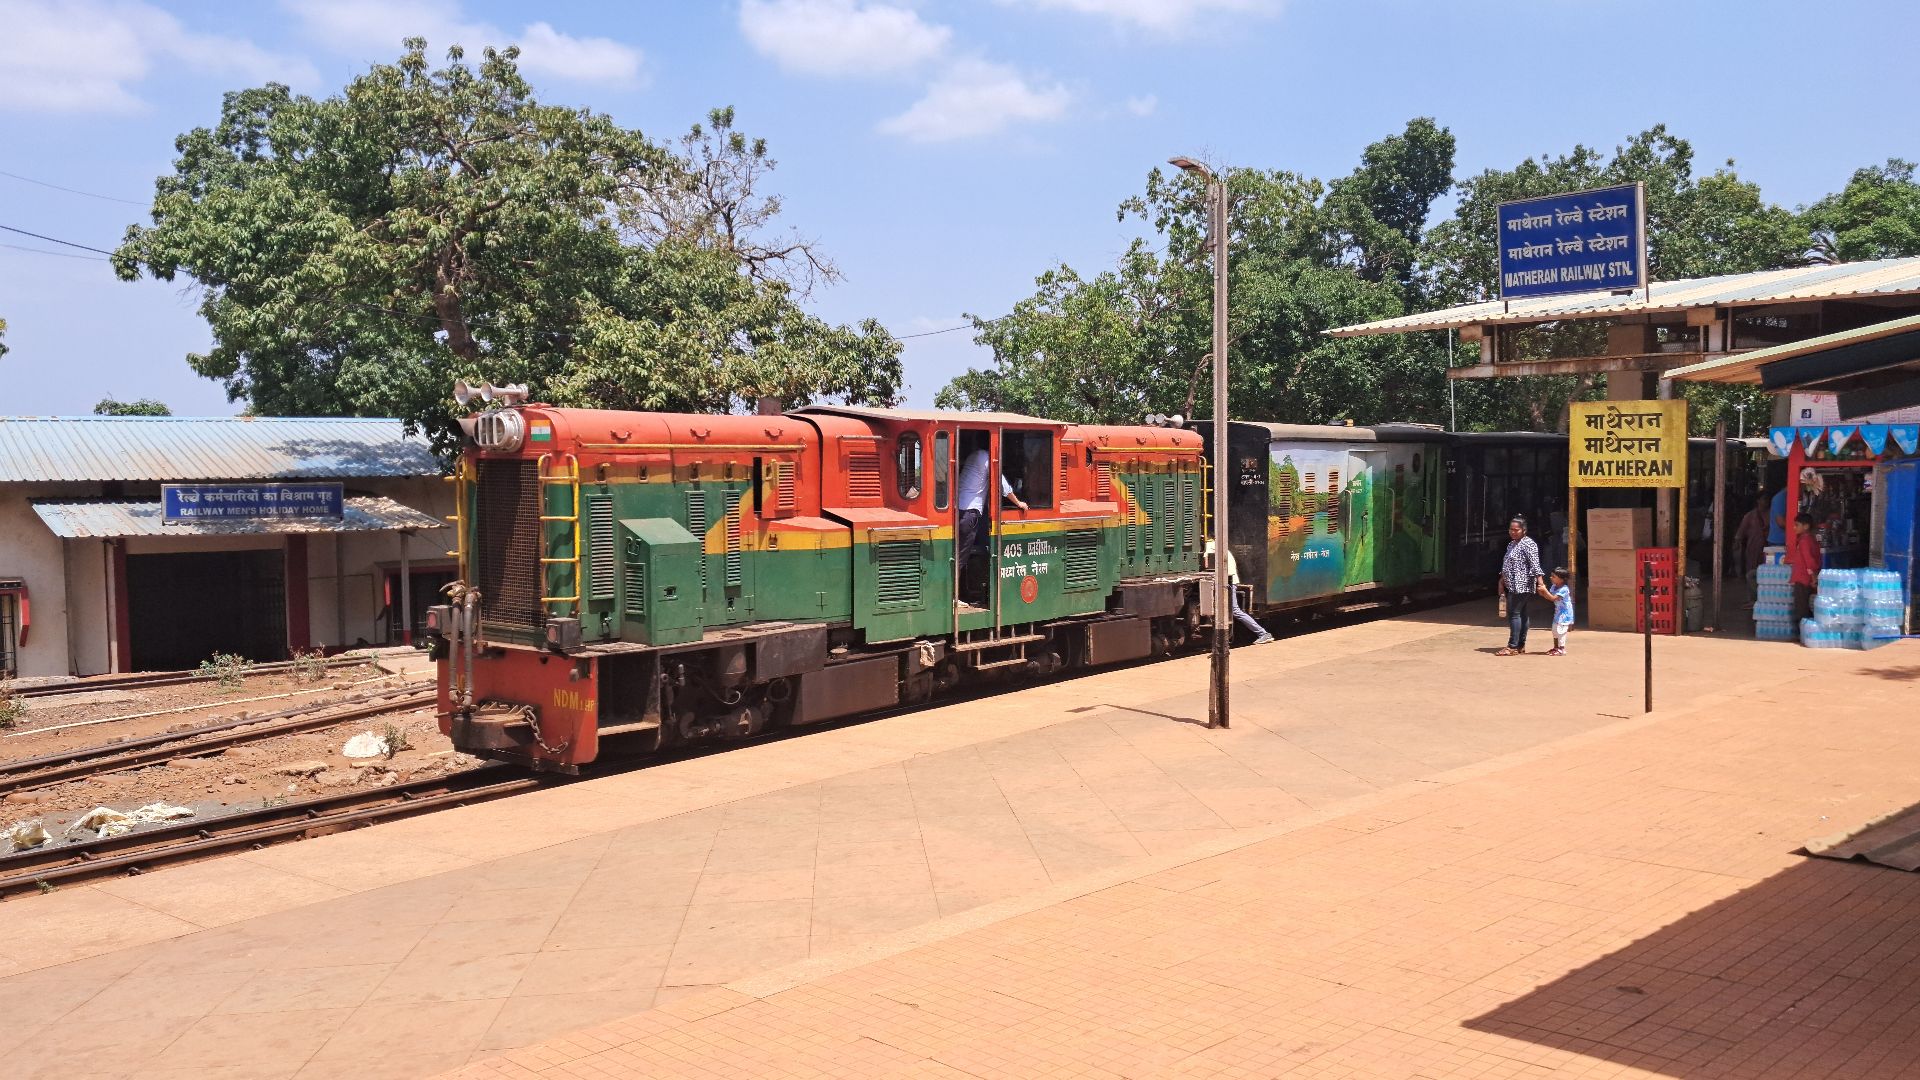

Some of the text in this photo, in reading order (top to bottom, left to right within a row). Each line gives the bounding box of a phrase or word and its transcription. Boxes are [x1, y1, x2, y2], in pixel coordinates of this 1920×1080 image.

[1507, 203, 1628, 231] माथेरान रेल्वे स्टेशन
[1508, 233, 1628, 261] माथेरान रेल्वे स्टेशन
[1505, 267, 1558, 288] MATHERAN
[1560, 263, 1605, 283] RAILWAY
[1584, 405, 1663, 431] माथेरान
[1584, 431, 1661, 455] माथेरान
[1578, 460, 1673, 476] MATHERAN
[204, 488, 259, 502] कर्मचारियों
[262, 491, 277, 502] का
[281, 488, 314, 502] विश्राम
[317, 491, 333, 504] गृह
[180, 505, 329, 516] RAILWAY MEN'S HOLIDAY HOME
[1003, 543, 1022, 558] 405
[1031, 560, 1049, 576] नेरल
